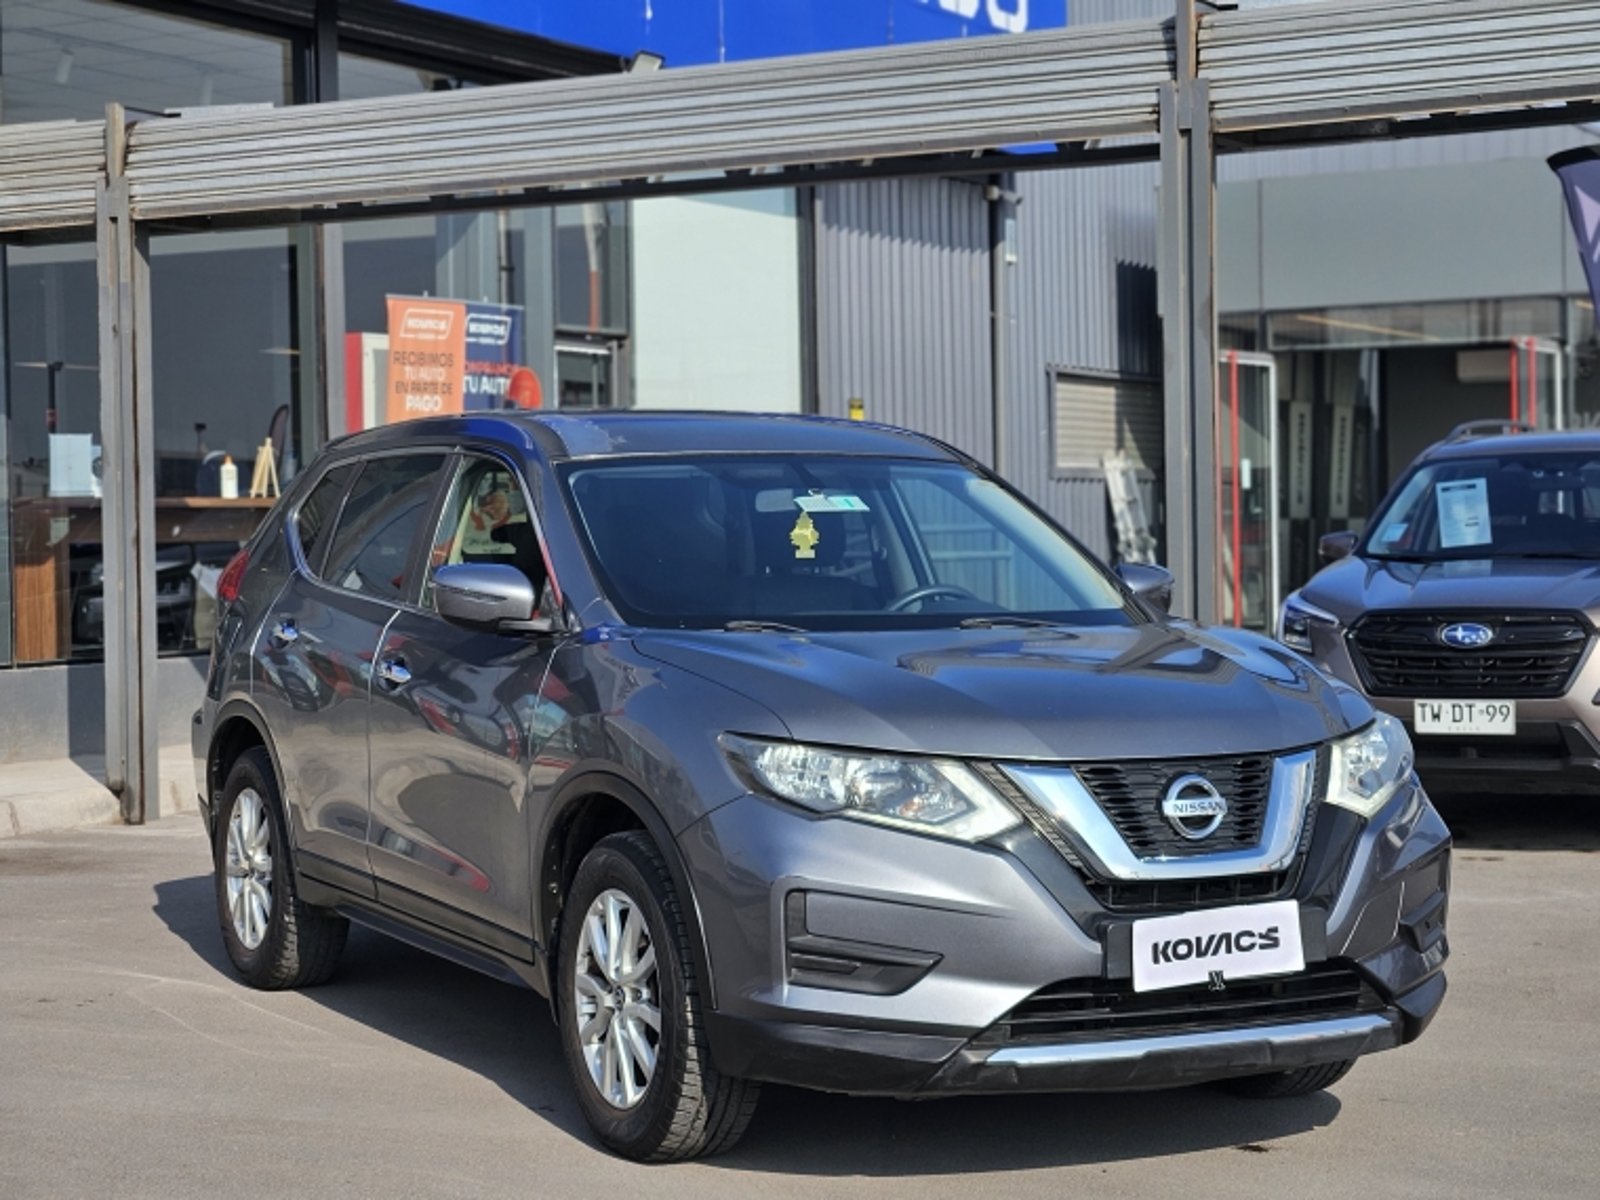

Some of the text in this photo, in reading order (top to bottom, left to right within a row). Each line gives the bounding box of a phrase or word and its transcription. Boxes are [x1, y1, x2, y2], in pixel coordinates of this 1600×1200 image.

[393, 351, 454, 367] RECIBIMOS
[404, 367, 446, 381] TU AUTO
[395, 381, 453, 395] EN PARTE DE
[463, 375, 479, 394] TU
[406, 395, 443, 411] PAGO
[1173, 801, 1222, 813] NISSAN
[1151, 926, 1280, 965] KOVACS
